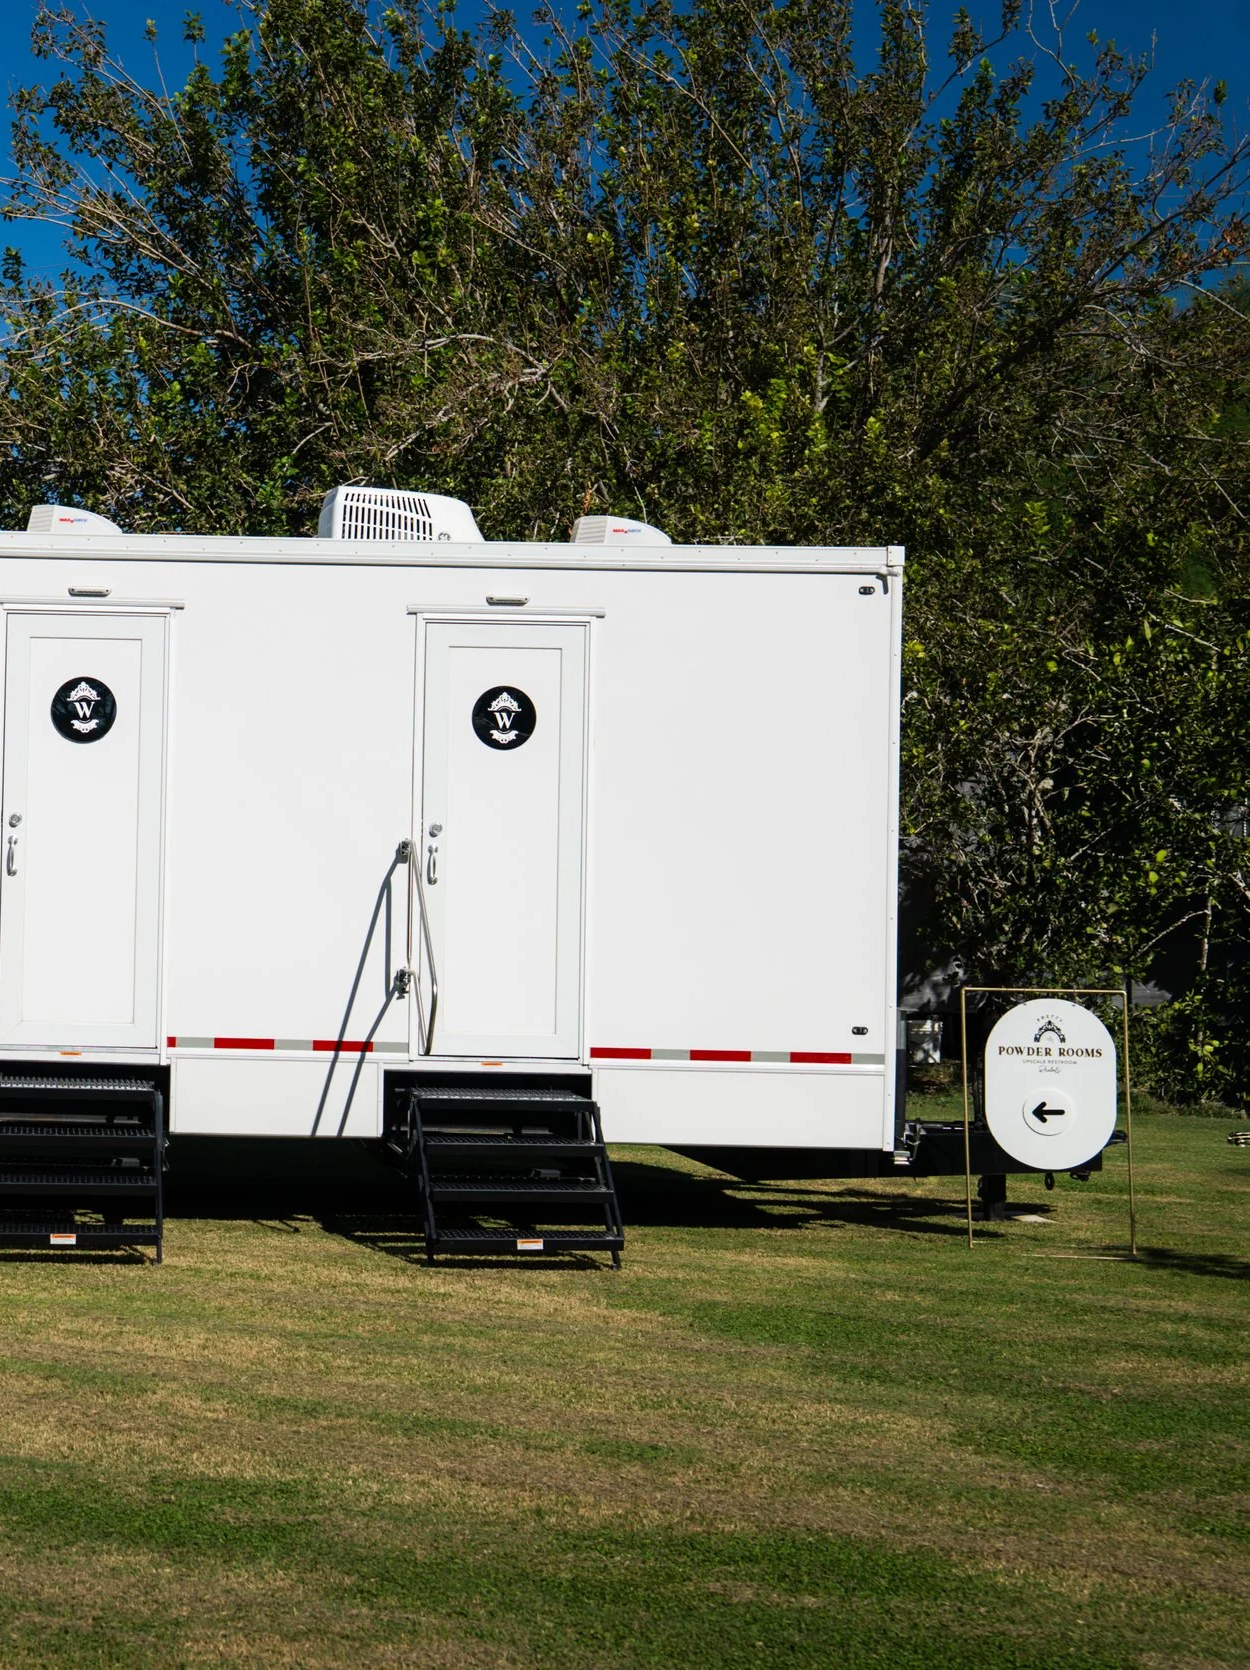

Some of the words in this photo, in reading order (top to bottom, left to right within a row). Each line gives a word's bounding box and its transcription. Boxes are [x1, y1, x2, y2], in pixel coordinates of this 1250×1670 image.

[73, 701, 96, 719] W
[493, 712, 516, 729] W
[998, 1046, 1053, 1057] POWDER
[1058, 1047, 1103, 1058] ROOMS
